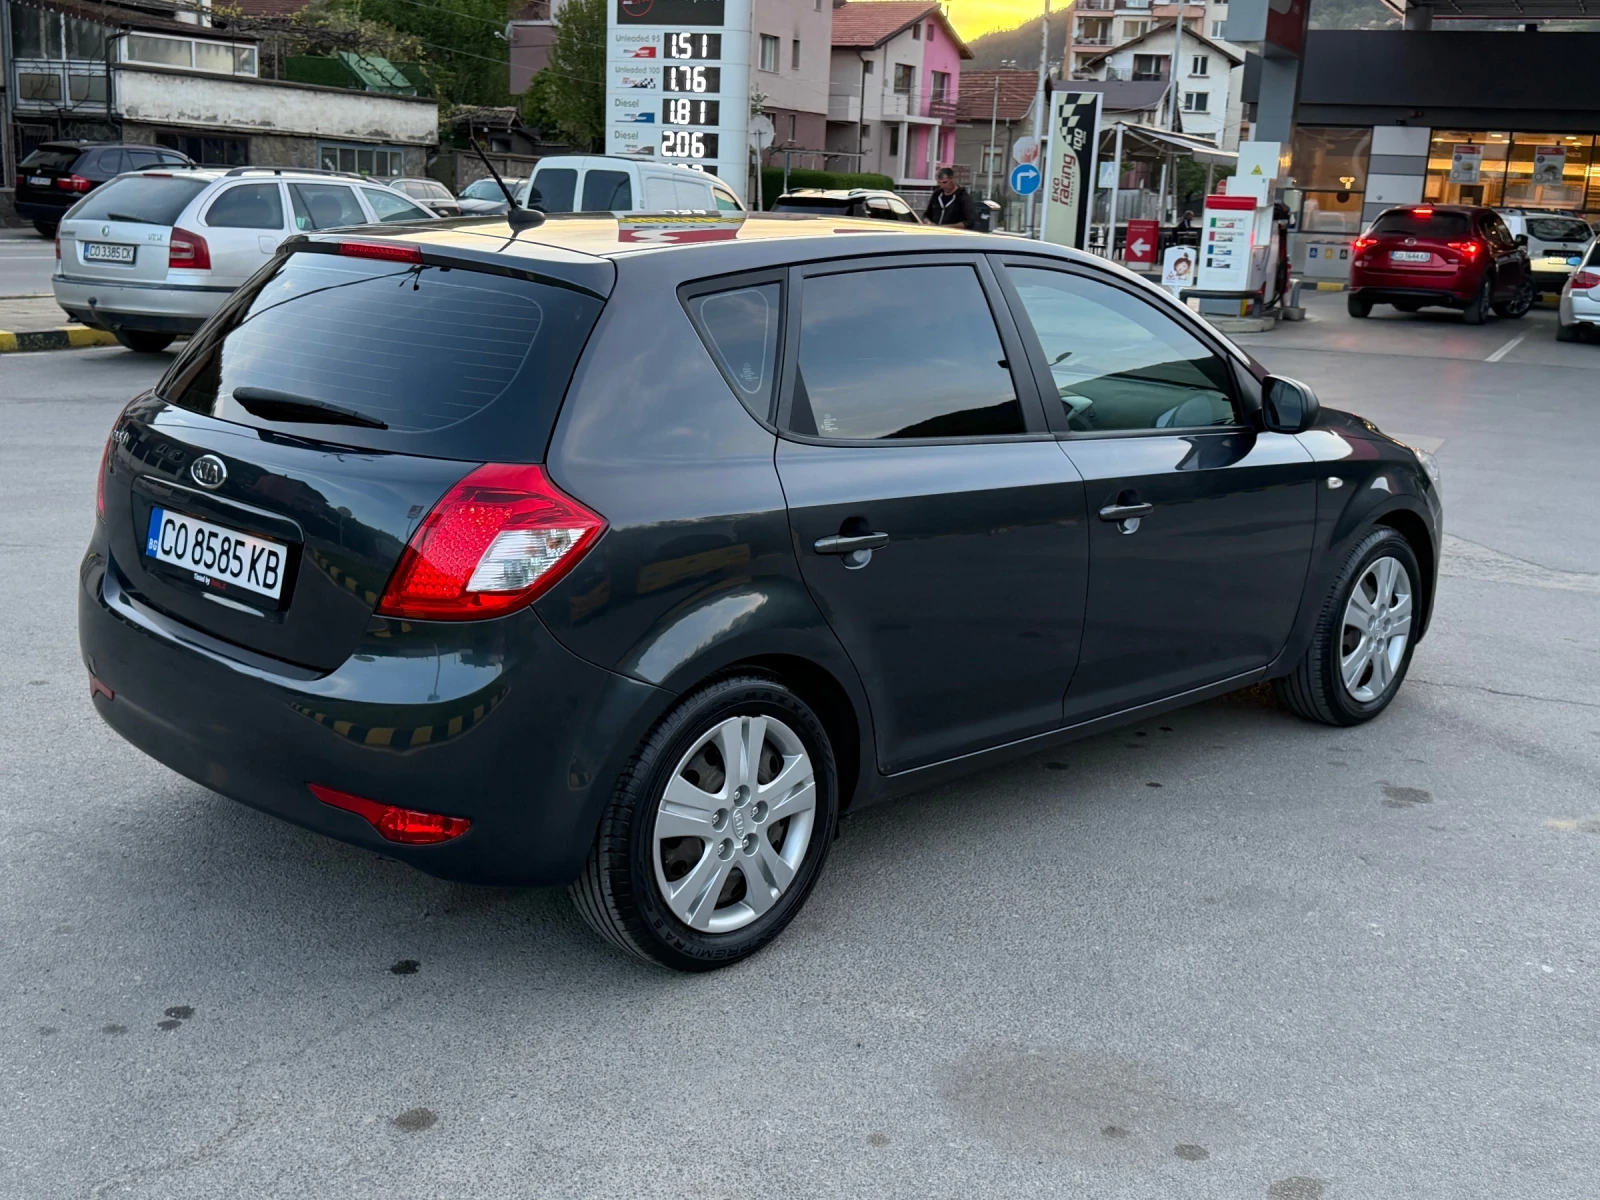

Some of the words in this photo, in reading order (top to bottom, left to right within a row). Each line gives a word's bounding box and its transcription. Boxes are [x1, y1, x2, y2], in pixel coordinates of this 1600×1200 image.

[615, 34, 649, 43] Unleaded
[649, 35, 661, 43] 95
[671, 32, 708, 59] 1.51
[614, 66, 648, 74] Unleaded
[670, 65, 707, 93] 1.76
[614, 98, 640, 108] Diesel
[669, 98, 706, 125] 1.81
[614, 130, 639, 140] Diesel
[661, 130, 705, 158] 2.06
[1073, 128, 1084, 151] 100
[1051, 177, 1060, 203] EKO
[1059, 153, 1076, 206] racing
[90, 245, 101, 257] CO
[101, 246, 121, 258] 3385
[121, 247, 133, 259] CK
[195, 460, 219, 483] KIA
[148, 537, 159, 551] BG
[161, 518, 189, 560] CO
[191, 527, 246, 578] 8585
[247, 544, 280, 590] KB
